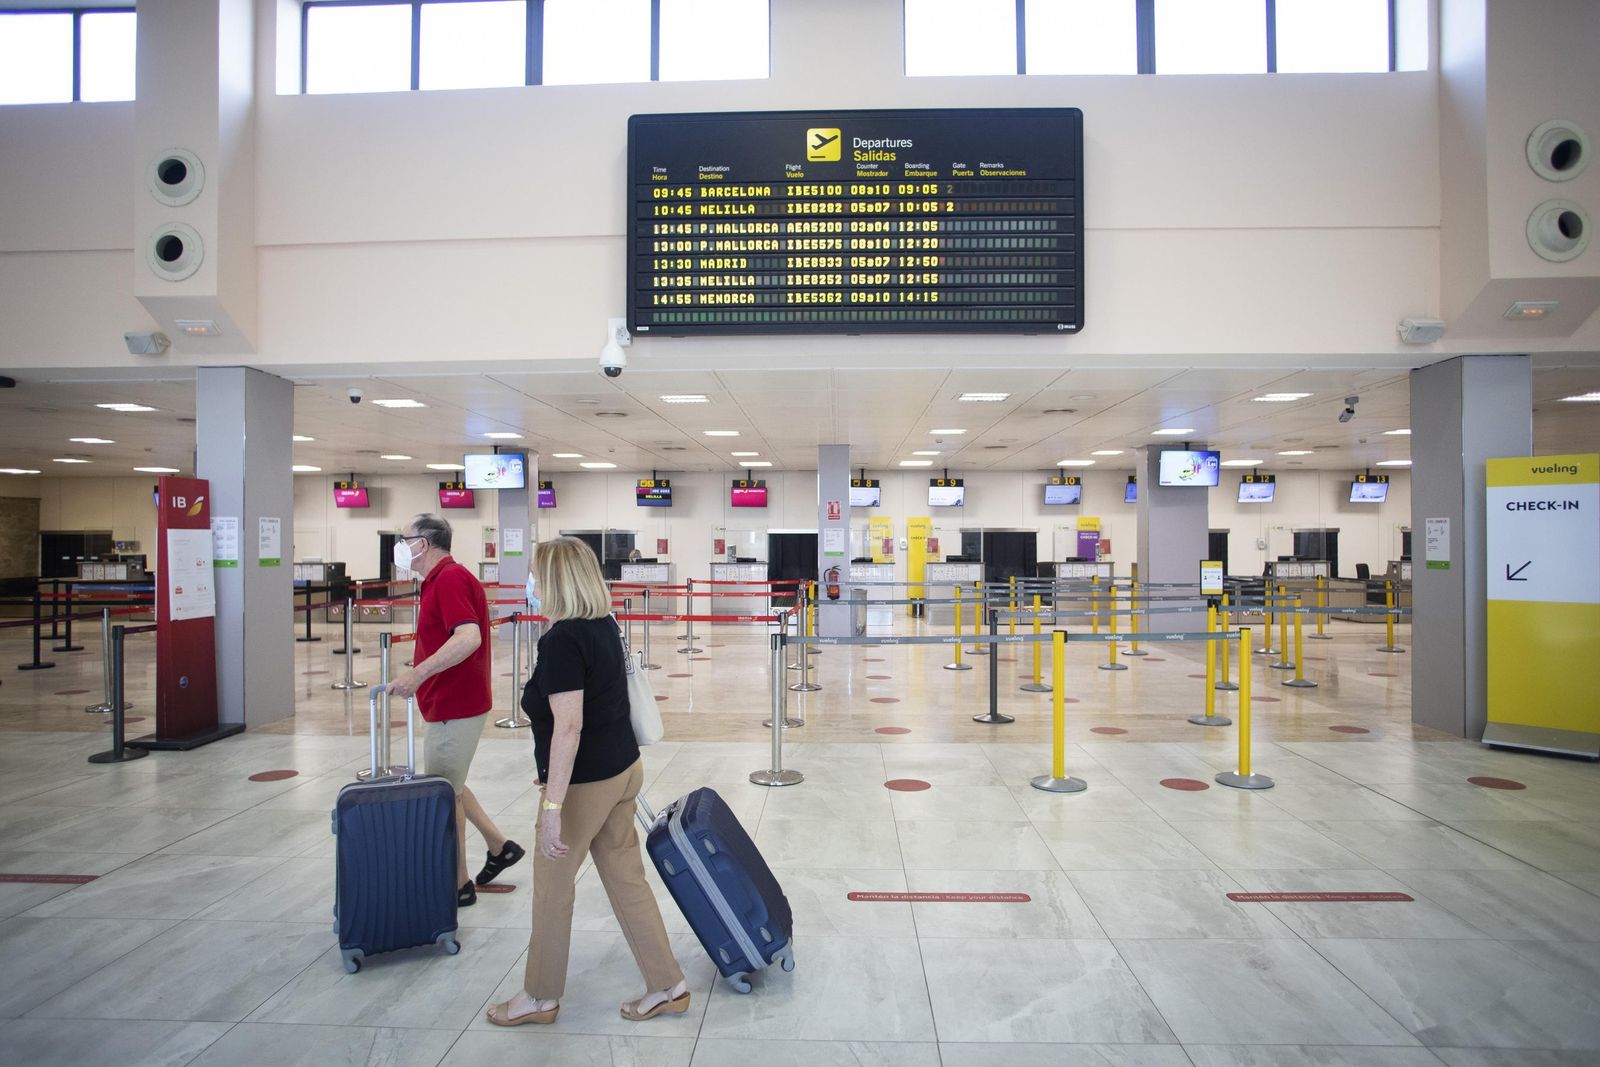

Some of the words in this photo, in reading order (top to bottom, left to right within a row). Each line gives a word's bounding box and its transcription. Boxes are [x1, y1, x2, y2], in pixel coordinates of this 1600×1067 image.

[853, 138, 913, 150] Departures
[853, 150, 897, 162] Salidas
[785, 164, 802, 172] Flight
[904, 162, 930, 170] Boarding
[904, 170, 938, 178] Embarque
[653, 188, 692, 198] 09:45
[700, 186, 771, 196] BARCELONA
[898, 184, 938, 195] 09:05
[946, 184, 954, 194] 2
[653, 206, 692, 216] 10:45
[700, 204, 755, 214] MELILLA
[898, 202, 938, 212] 10:05
[946, 202, 954, 212] 2
[653, 224, 692, 234] 12:45
[700, 224, 778, 234] P.MALLORCA
[898, 222, 938, 232] 12:05
[653, 241, 692, 251] 13:00
[700, 240, 778, 250] P.MALLORCA
[898, 238, 938, 249] 12:20
[653, 259, 692, 269] 13:30
[700, 258, 747, 268] MADRID
[898, 257, 938, 267] 12:50
[653, 276, 692, 286] 13:35
[700, 276, 755, 286] MELILLA
[898, 274, 938, 284] 12:55
[653, 294, 692, 304] 14:55
[700, 294, 755, 304] MENORCA
[898, 292, 938, 302] 14:15
[1531, 464, 1578, 475] vueling
[1064, 476, 1075, 485] 10
[172, 496, 187, 508] IB
[1506, 500, 1579, 511] CHECK-IN
